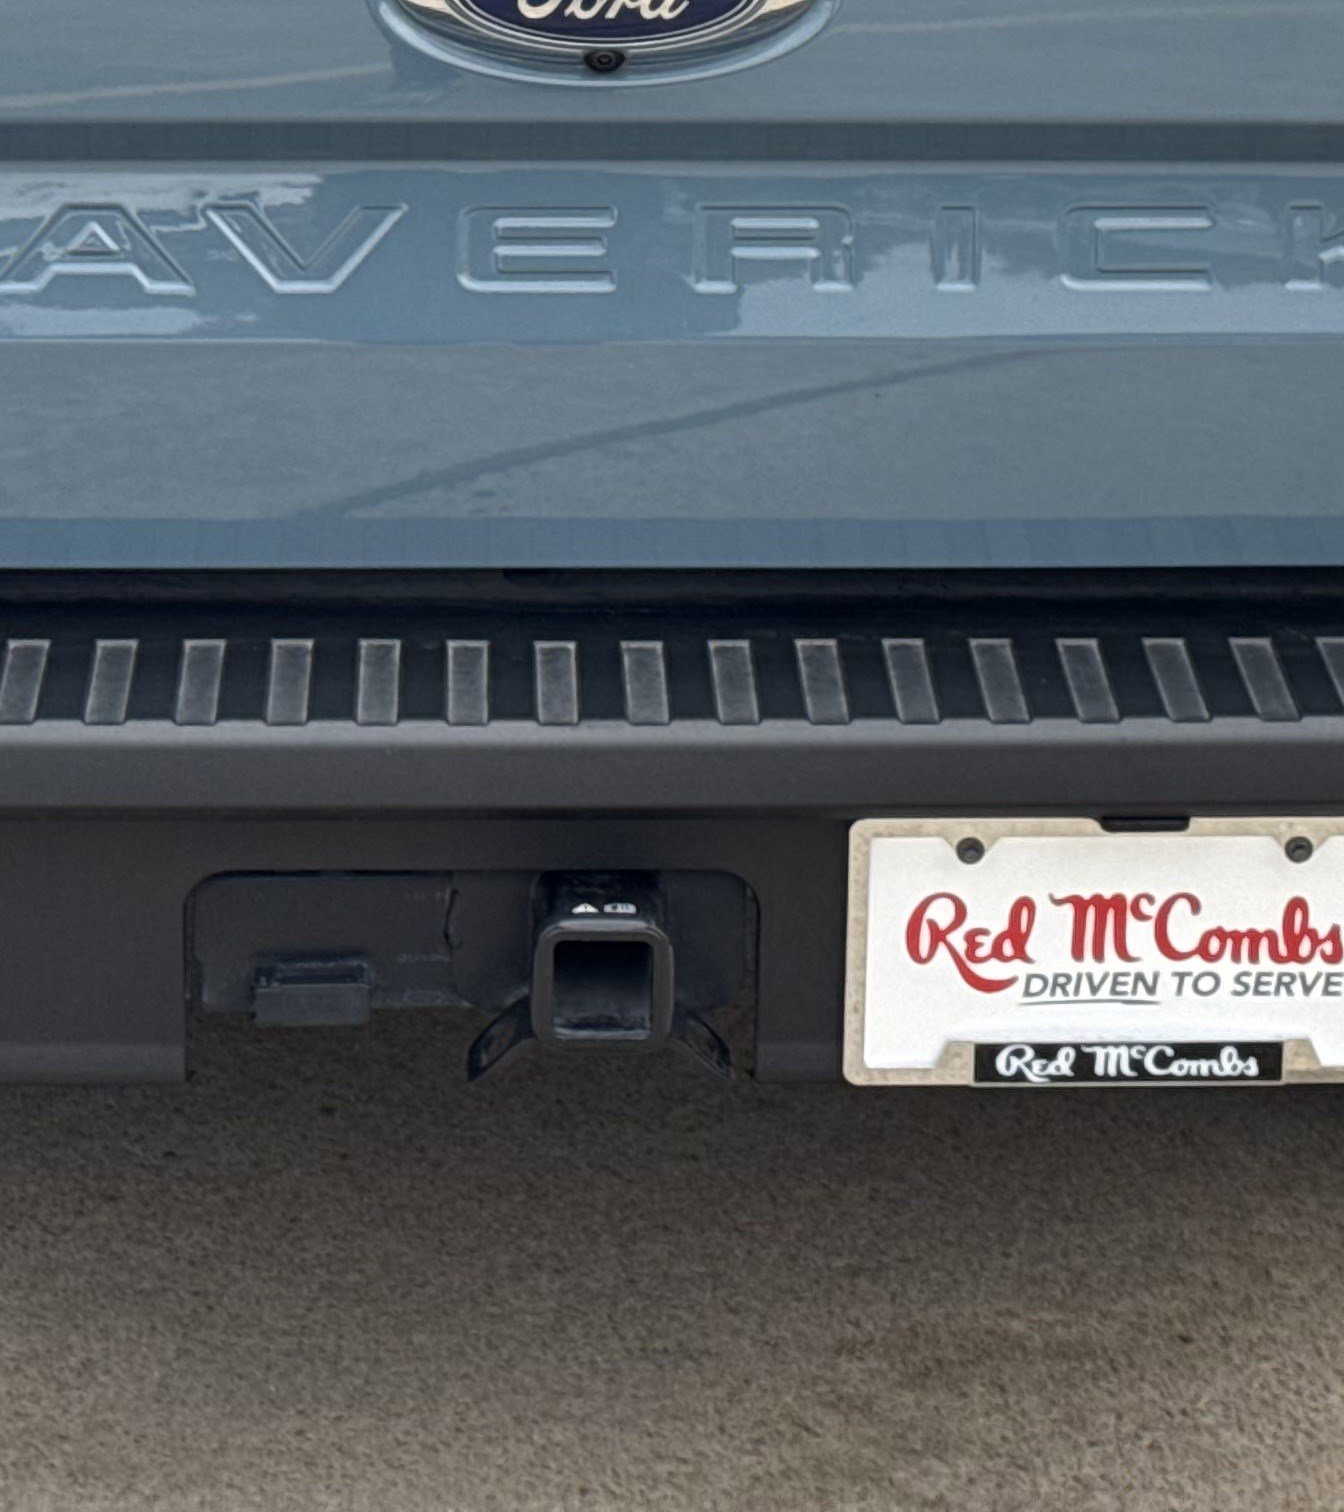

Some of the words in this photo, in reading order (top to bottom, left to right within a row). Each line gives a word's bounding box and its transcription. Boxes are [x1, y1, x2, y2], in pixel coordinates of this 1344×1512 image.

[905, 892, 1037, 994] Red
[1048, 892, 1344, 965] McCombs
[1022, 971, 1160, 998] DRIVEN
[1170, 971, 1222, 997] TO
[995, 1044, 1076, 1084] Red
[1080, 1044, 1260, 1077] McCombs
